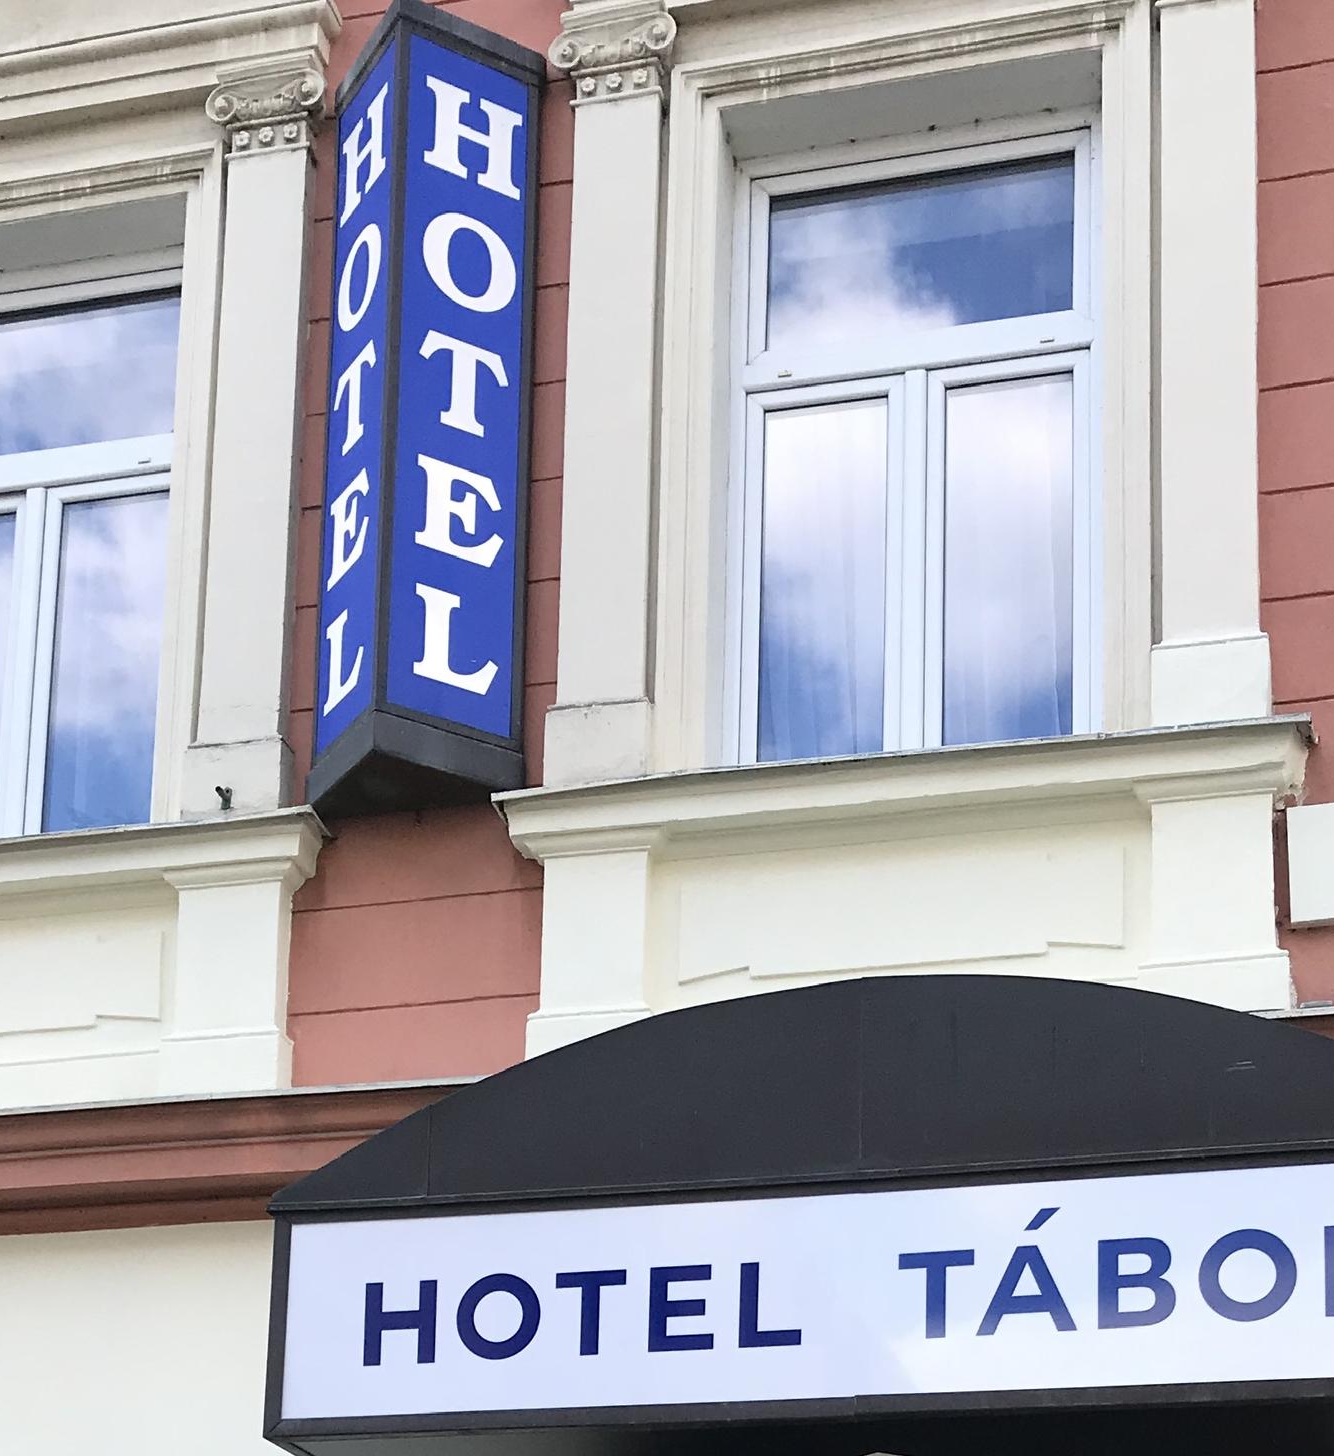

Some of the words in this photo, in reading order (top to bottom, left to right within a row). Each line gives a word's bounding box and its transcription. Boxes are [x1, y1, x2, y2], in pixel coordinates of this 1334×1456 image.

[324, 82, 389, 717] HOTEL
[413, 74, 523, 696] HOTEL
[362, 1261, 803, 1367] HOTEL
